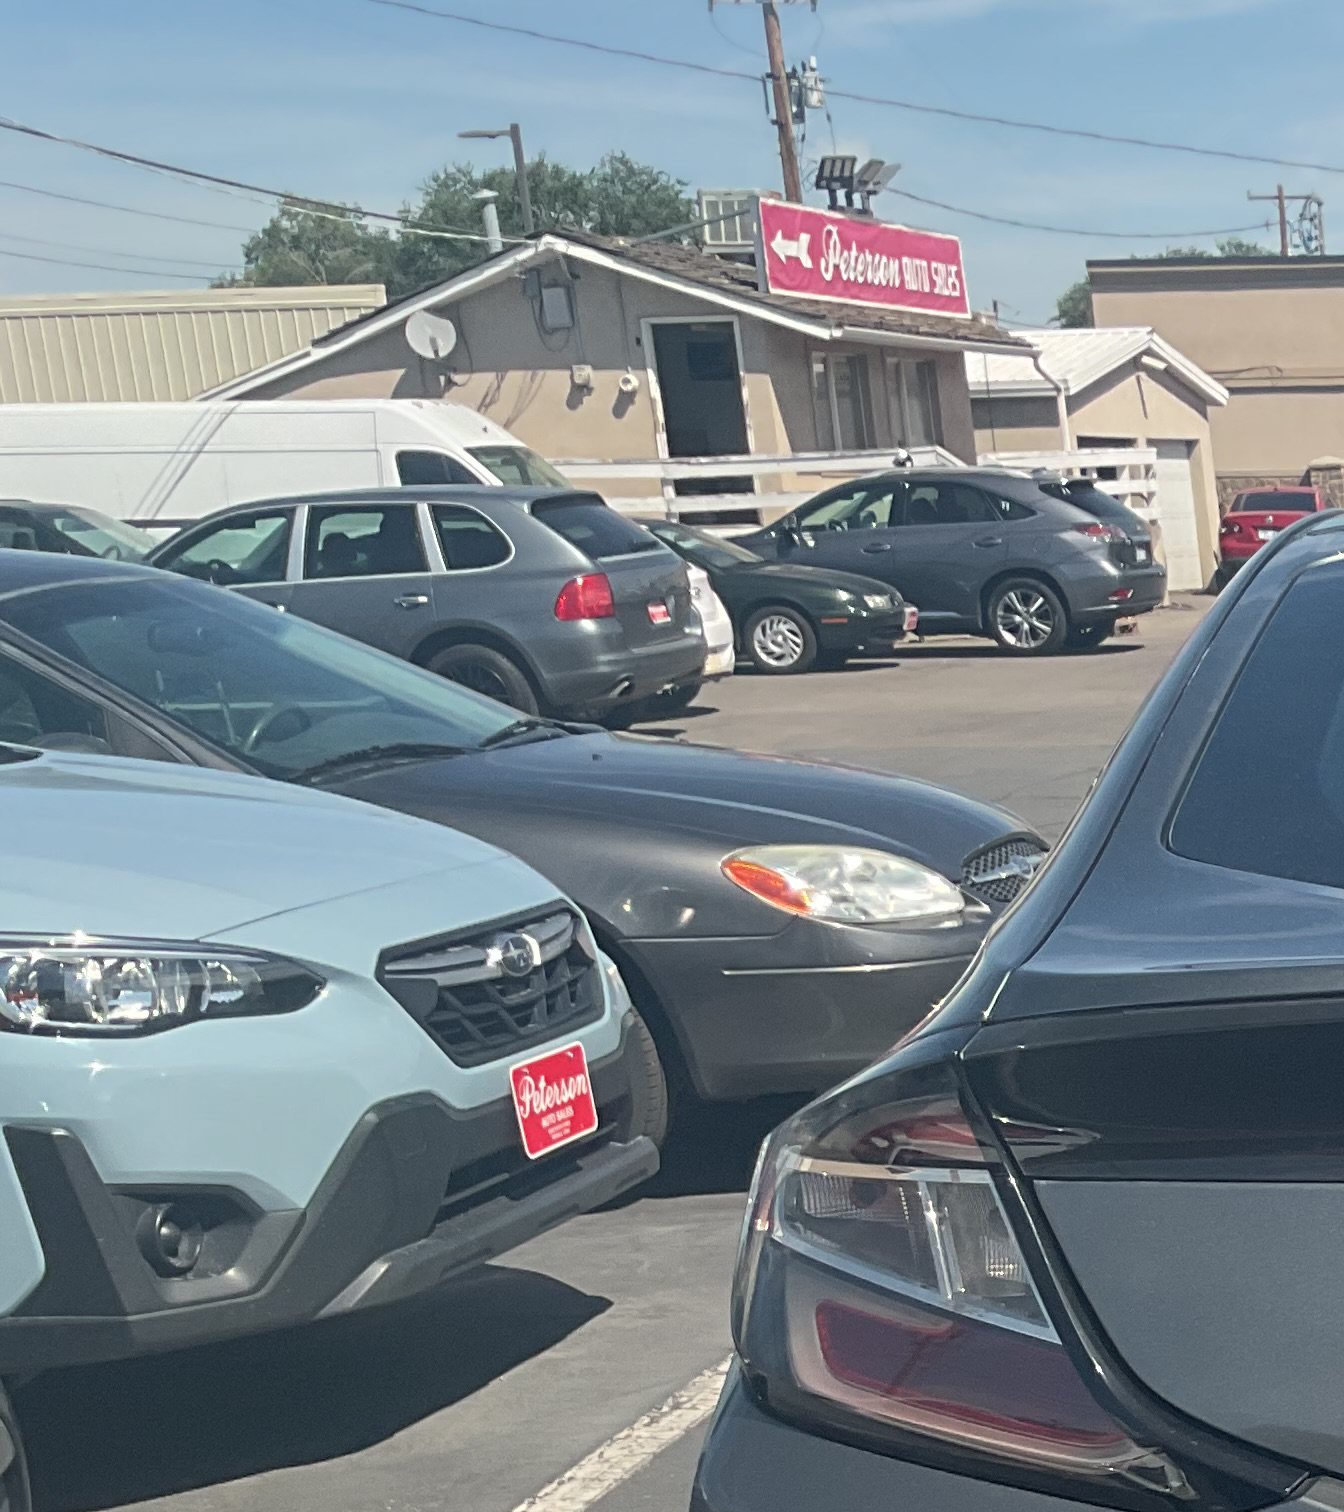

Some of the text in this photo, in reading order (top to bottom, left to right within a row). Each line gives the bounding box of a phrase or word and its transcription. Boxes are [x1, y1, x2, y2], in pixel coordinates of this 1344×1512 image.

[820, 224, 960, 296] Peterson AUTO SALES
[519, 1074, 588, 1119] Peterson
